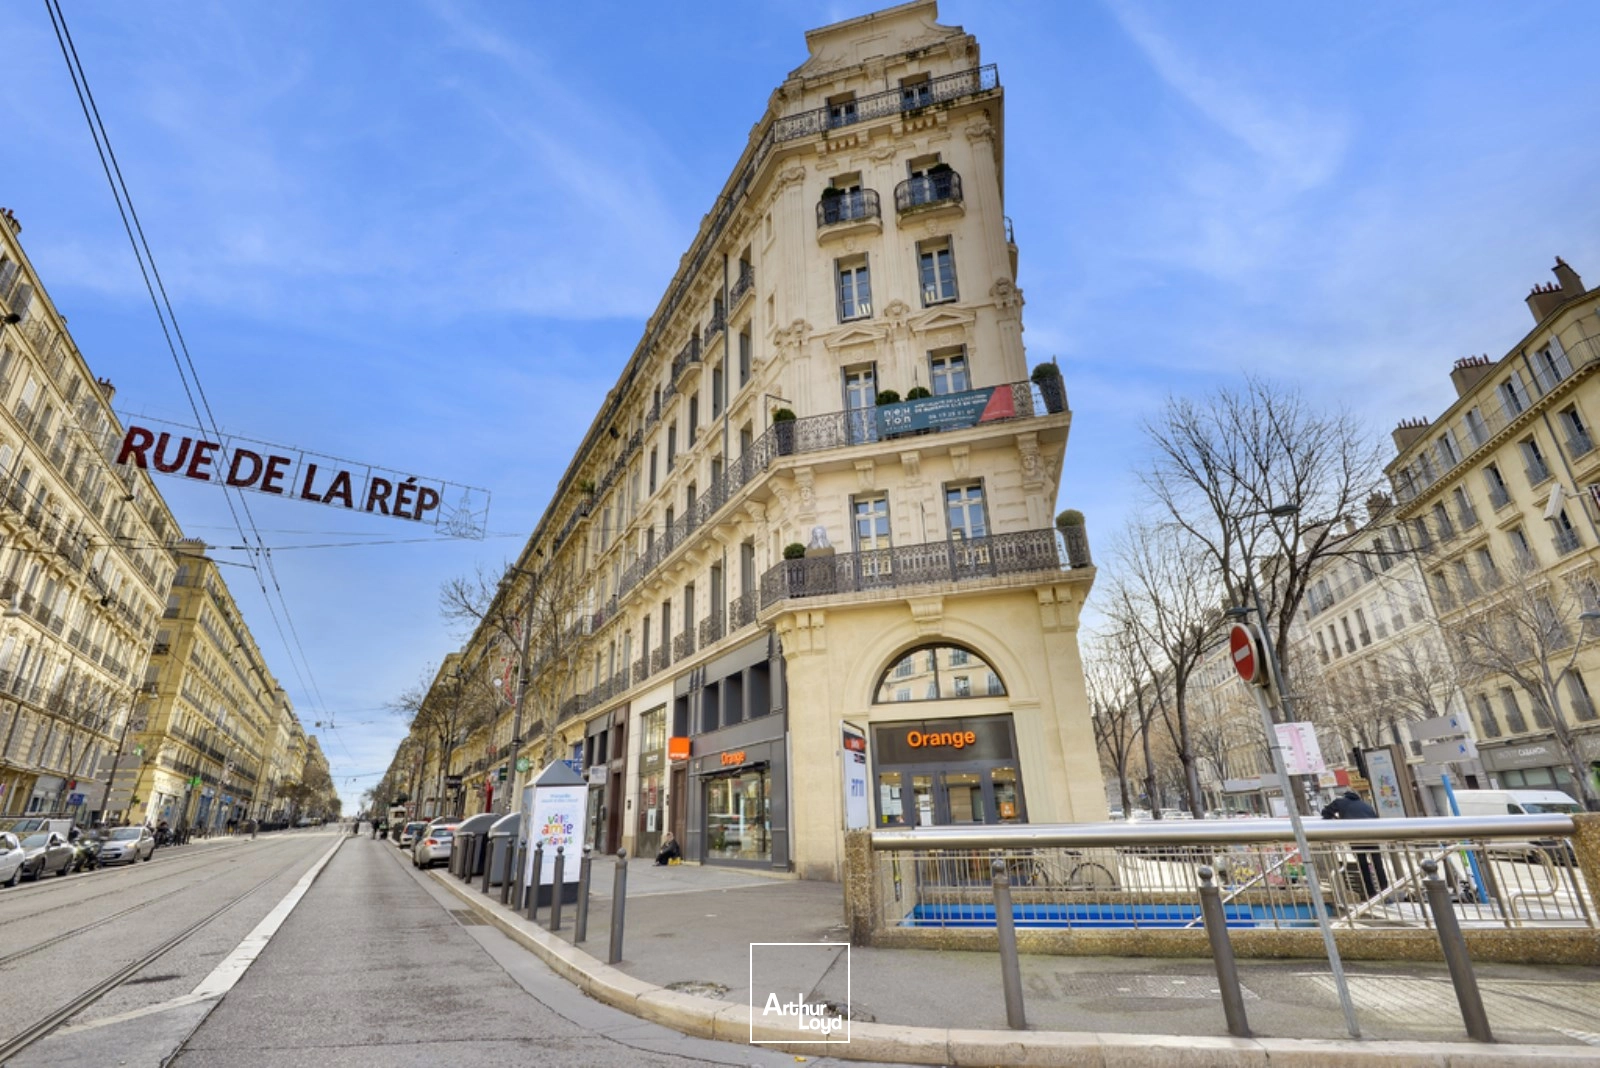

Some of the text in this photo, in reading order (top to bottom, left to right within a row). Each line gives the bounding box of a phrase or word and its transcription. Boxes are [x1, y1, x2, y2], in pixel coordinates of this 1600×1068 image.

[117, 426, 440, 521] RUE DE LA RÉP
[907, 730, 976, 749] Orange
[721, 751, 746, 766] Orange
[541, 823, 574, 836] amie
